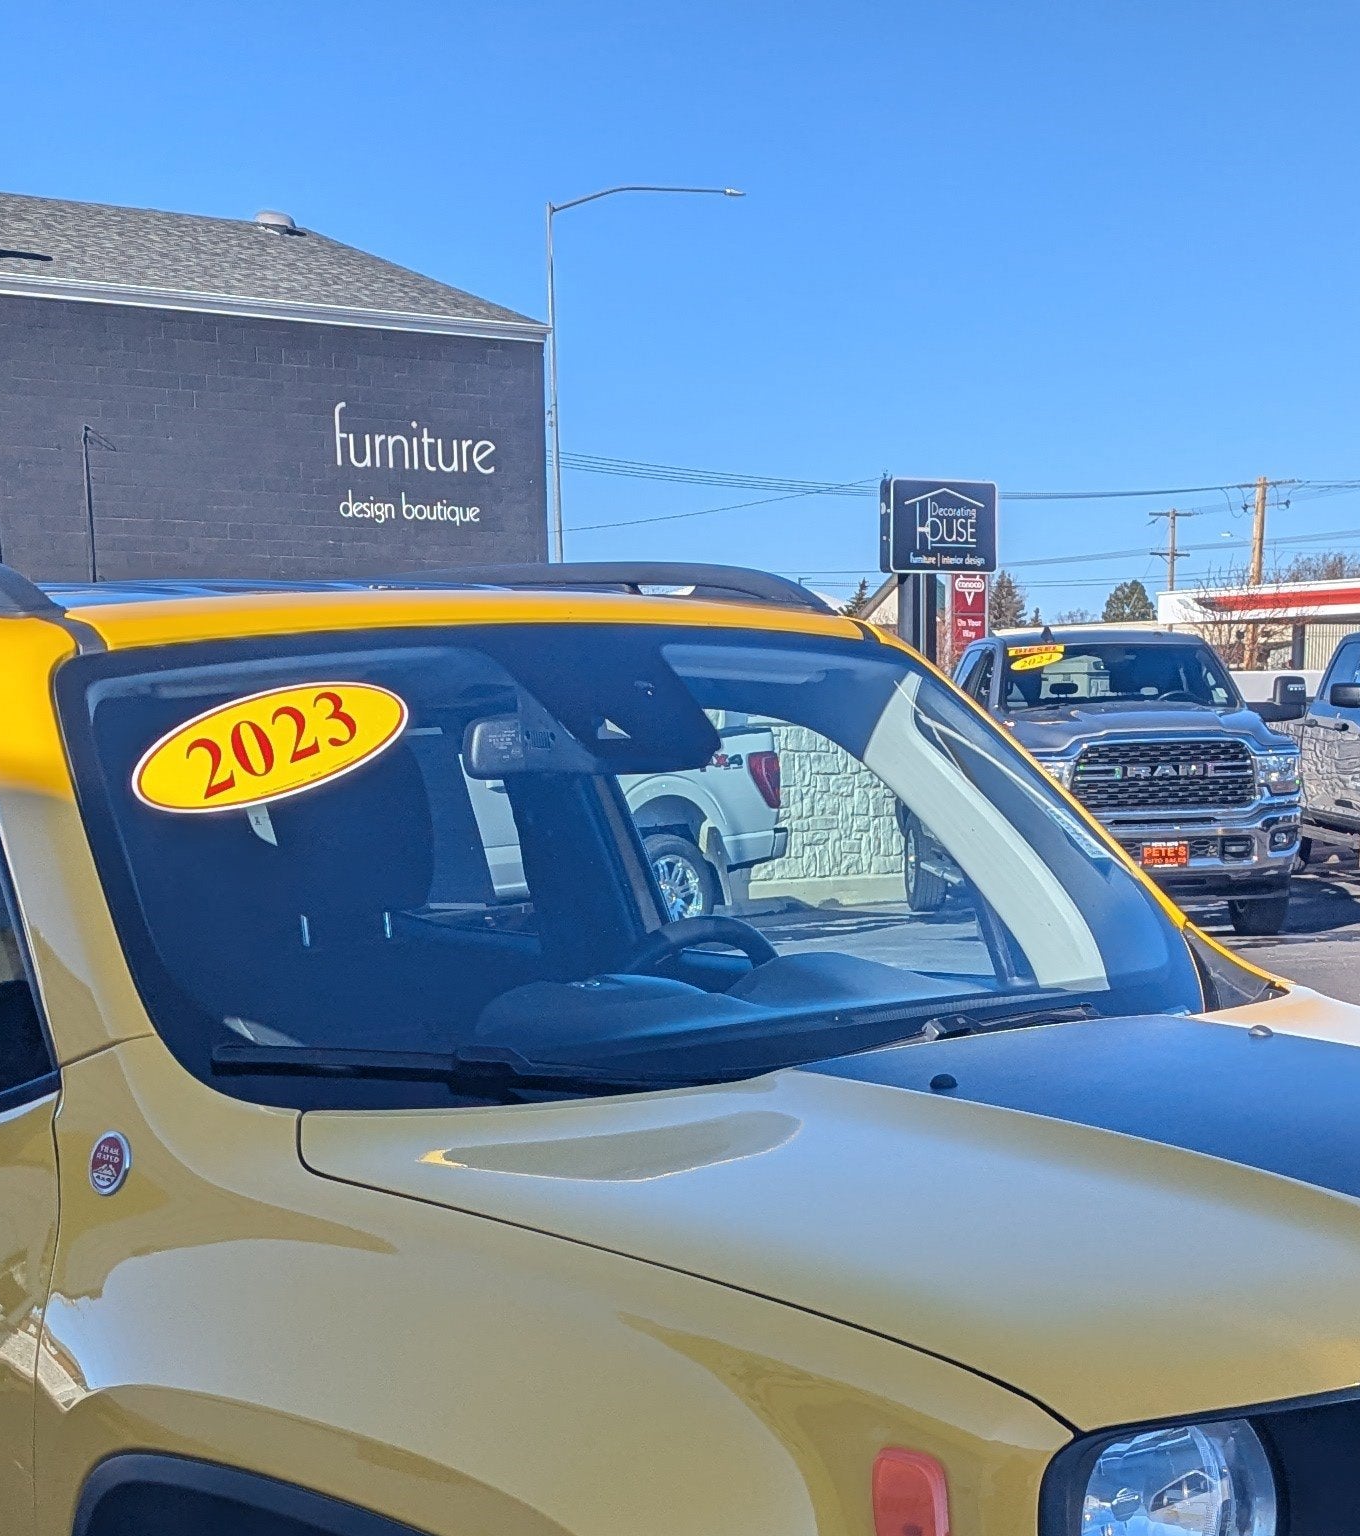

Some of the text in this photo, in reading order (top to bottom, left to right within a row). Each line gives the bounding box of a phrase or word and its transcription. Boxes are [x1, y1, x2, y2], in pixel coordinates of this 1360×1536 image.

[334, 401, 496, 474] furniture
[339, 489, 480, 526] design boutique
[931, 501, 977, 520] Decorating
[910, 552, 985, 566] furniture interior design
[1014, 645, 1057, 655] DIESEL
[1020, 653, 1053, 669] 2024
[187, 692, 356, 799] 2023
[1127, 764, 1204, 777] RAM
[1143, 845, 1187, 857] PETE'S
[96, 1152, 120, 1163] RATED
